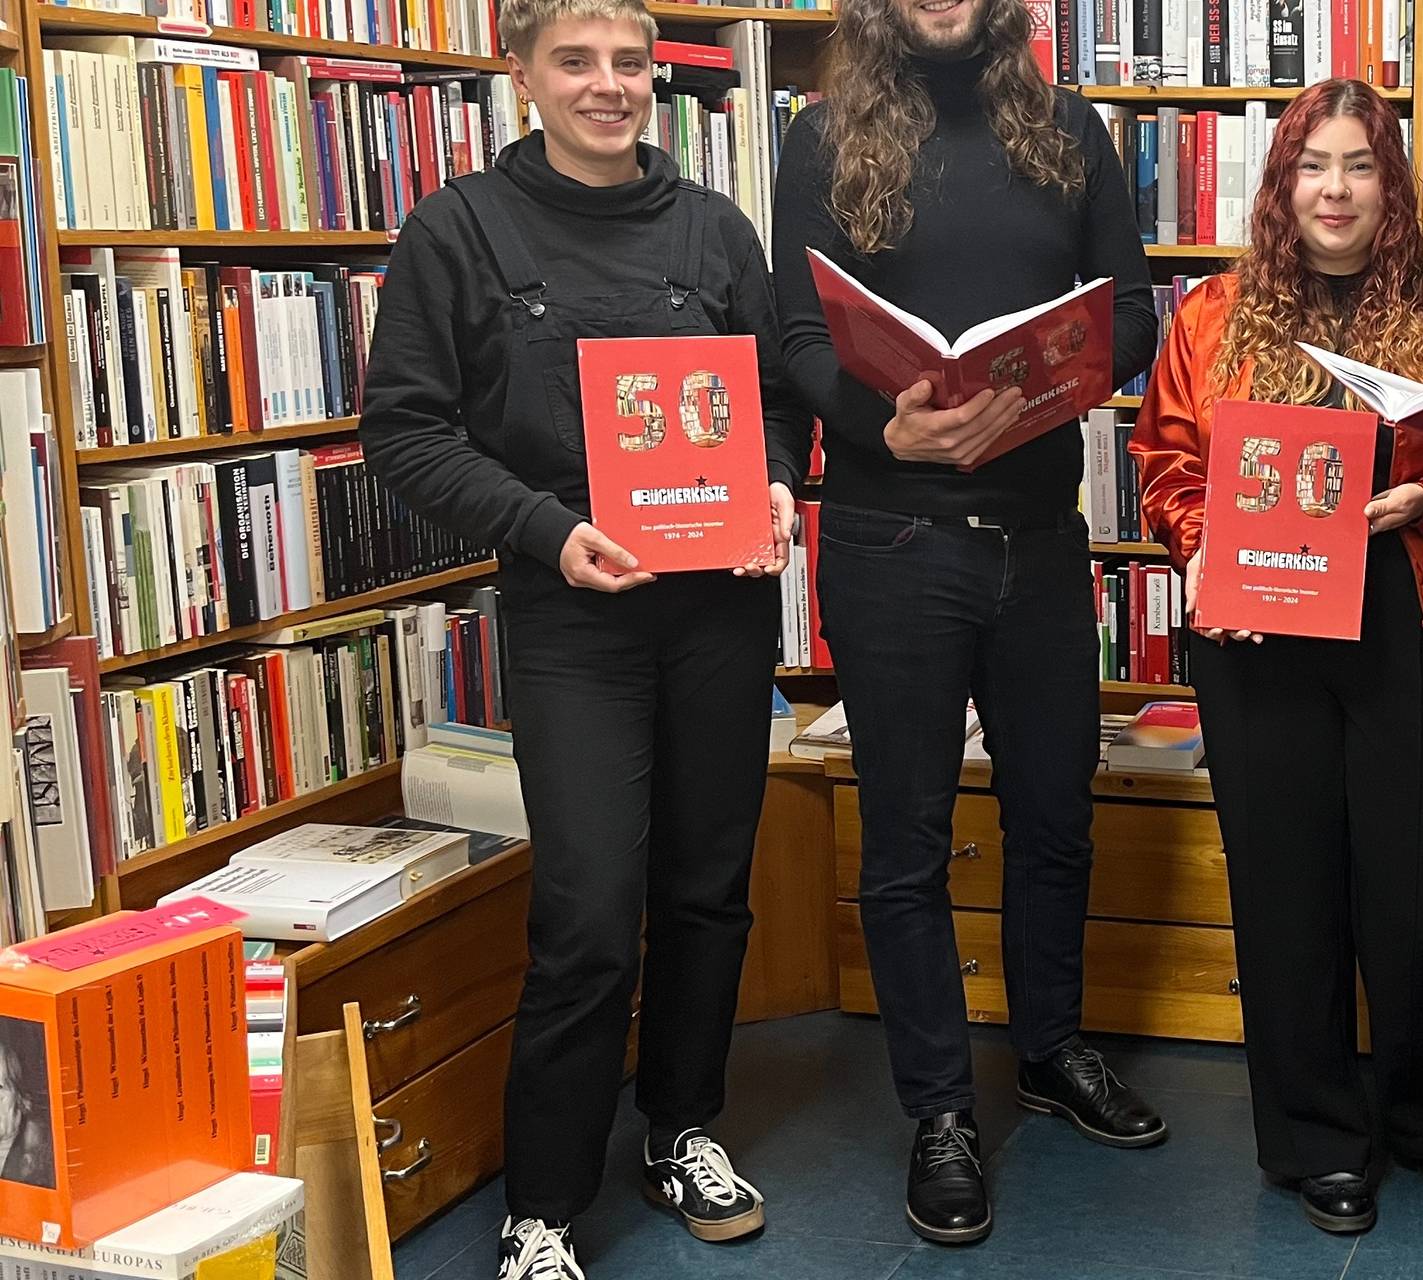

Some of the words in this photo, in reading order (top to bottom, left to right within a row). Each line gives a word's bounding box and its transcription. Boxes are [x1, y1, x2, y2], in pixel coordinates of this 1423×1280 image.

[1209, 24, 1220, 43] DER
[1273, 20, 1282, 33] SS
[1061, 20, 1070, 71] BRAUNES
[49, 86, 60, 156] ARBEITERUNION
[257, 207, 265, 220] LEO
[101, 283, 109, 322] VORSPIEL
[127, 307, 135, 333] KRIEG
[162, 304, 170, 342] Faschismus
[165, 357, 175, 408] Gewerkschaften
[1021, 377, 1080, 413] CHERKISTE
[616, 370, 732, 452] 50
[1236, 436, 1344, 519] 50
[239, 467, 249, 512] TERRORS
[638, 486, 730, 506] BÜCHERKISTE
[233, 468, 247, 540] ORGANISATION
[244, 512, 252, 532] DES
[310, 497, 321, 542] STAATSRÄTE
[263, 494, 275, 571] Behemoth
[664, 532, 681, 540] 1974
[687, 531, 704, 539] 2024
[241, 542, 250, 559] DIE
[312, 543, 321, 557] DIE
[1245, 549, 1329, 573] BÜCHERKISTE
[1262, 594, 1277, 602] 1974
[1283, 596, 1299, 604] 2024
[1153, 596, 1162, 630] Kursbuch
[189, 680, 199, 727] Unschuld
[189, 731, 198, 773] Wolfgang
[105, 991, 113, 1011] Logik
[136, 981, 145, 1003] Logik
[230, 1011, 238, 1031] Hegel
[111, 1077, 119, 1098] Hegel
[142, 1067, 150, 1088] Hegel
[78, 1103, 86, 1125] Hegel
[176, 1101, 185, 1121] Hegel
[210, 1119, 218, 1138] Hegel
[92, 1249, 163, 1271] EUROPAS
